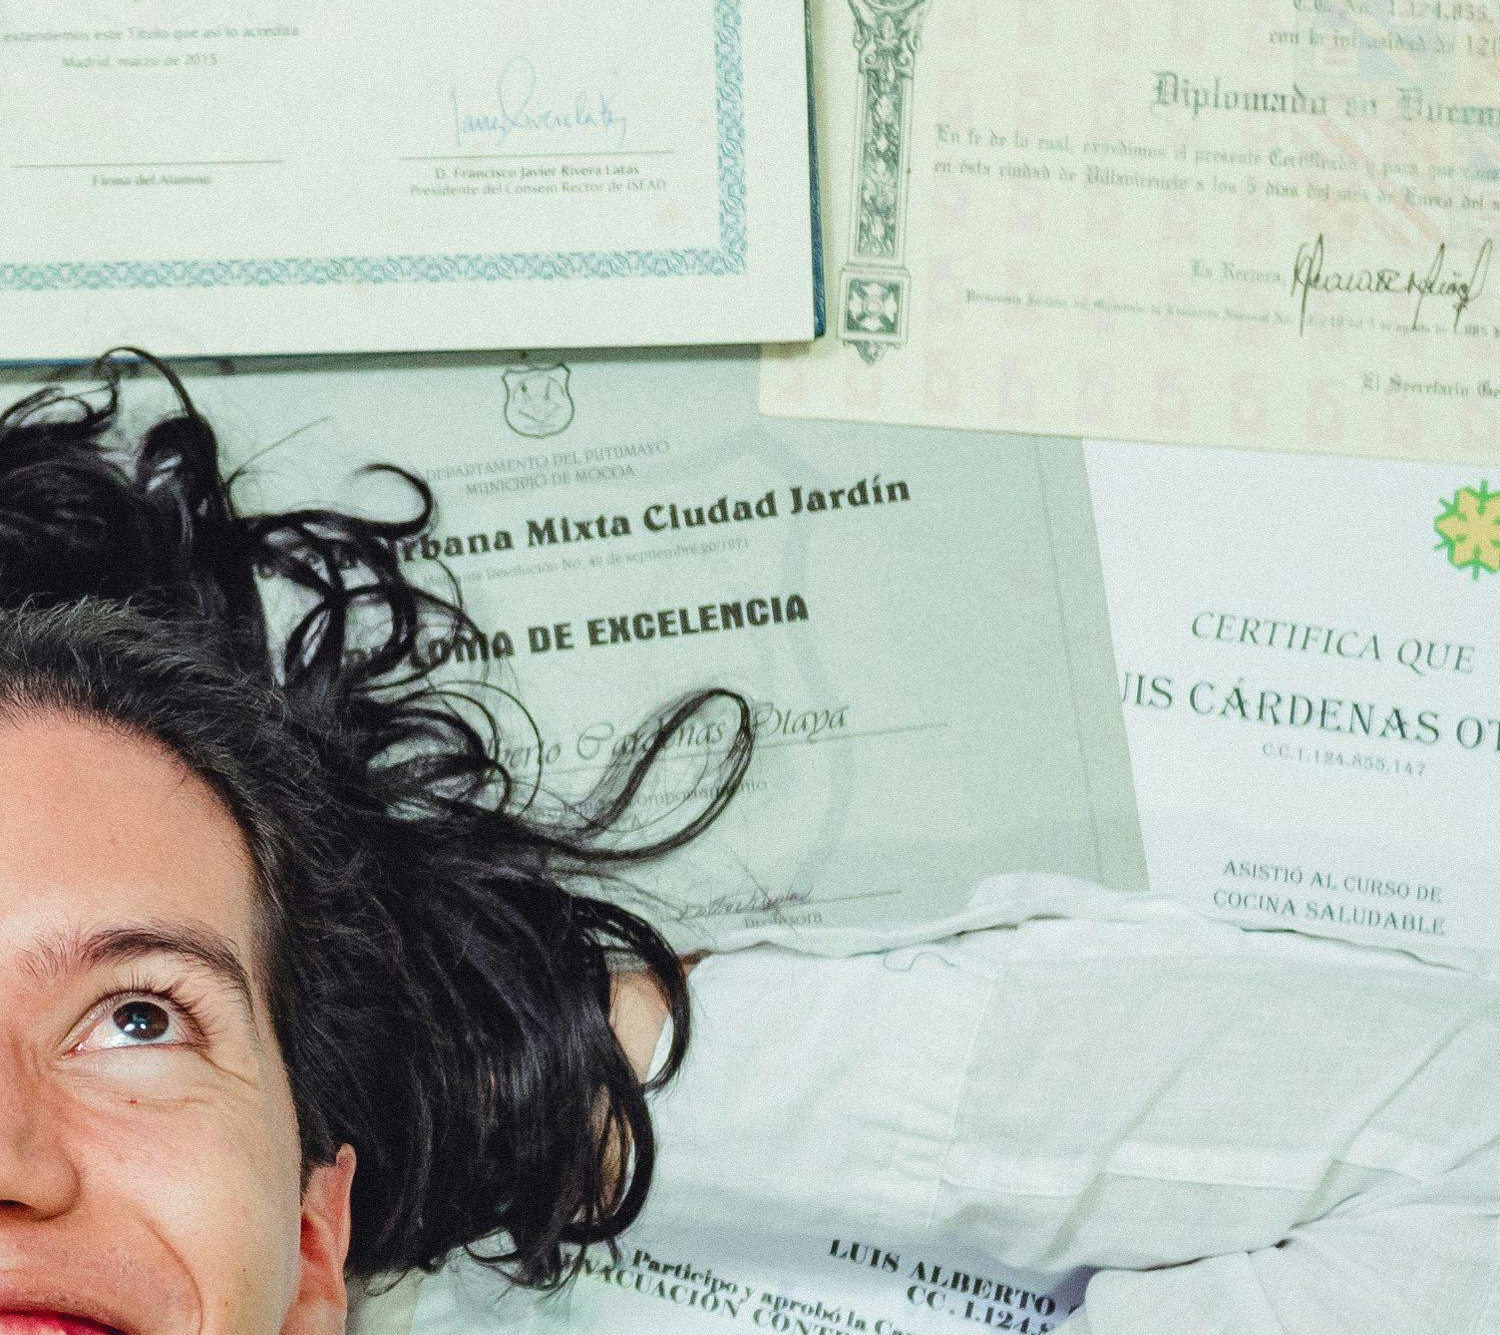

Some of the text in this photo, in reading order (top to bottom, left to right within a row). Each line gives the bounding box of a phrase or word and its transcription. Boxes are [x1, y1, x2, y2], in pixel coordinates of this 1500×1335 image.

[525, 474, 911, 547] Mixta Ciudad Jardín
[528, 594, 809, 653] DE EXCELENCIA
[1191, 611, 1476, 674] CERTIFICA QUE
[1189, 677, 1441, 746] CÁRDENAS
